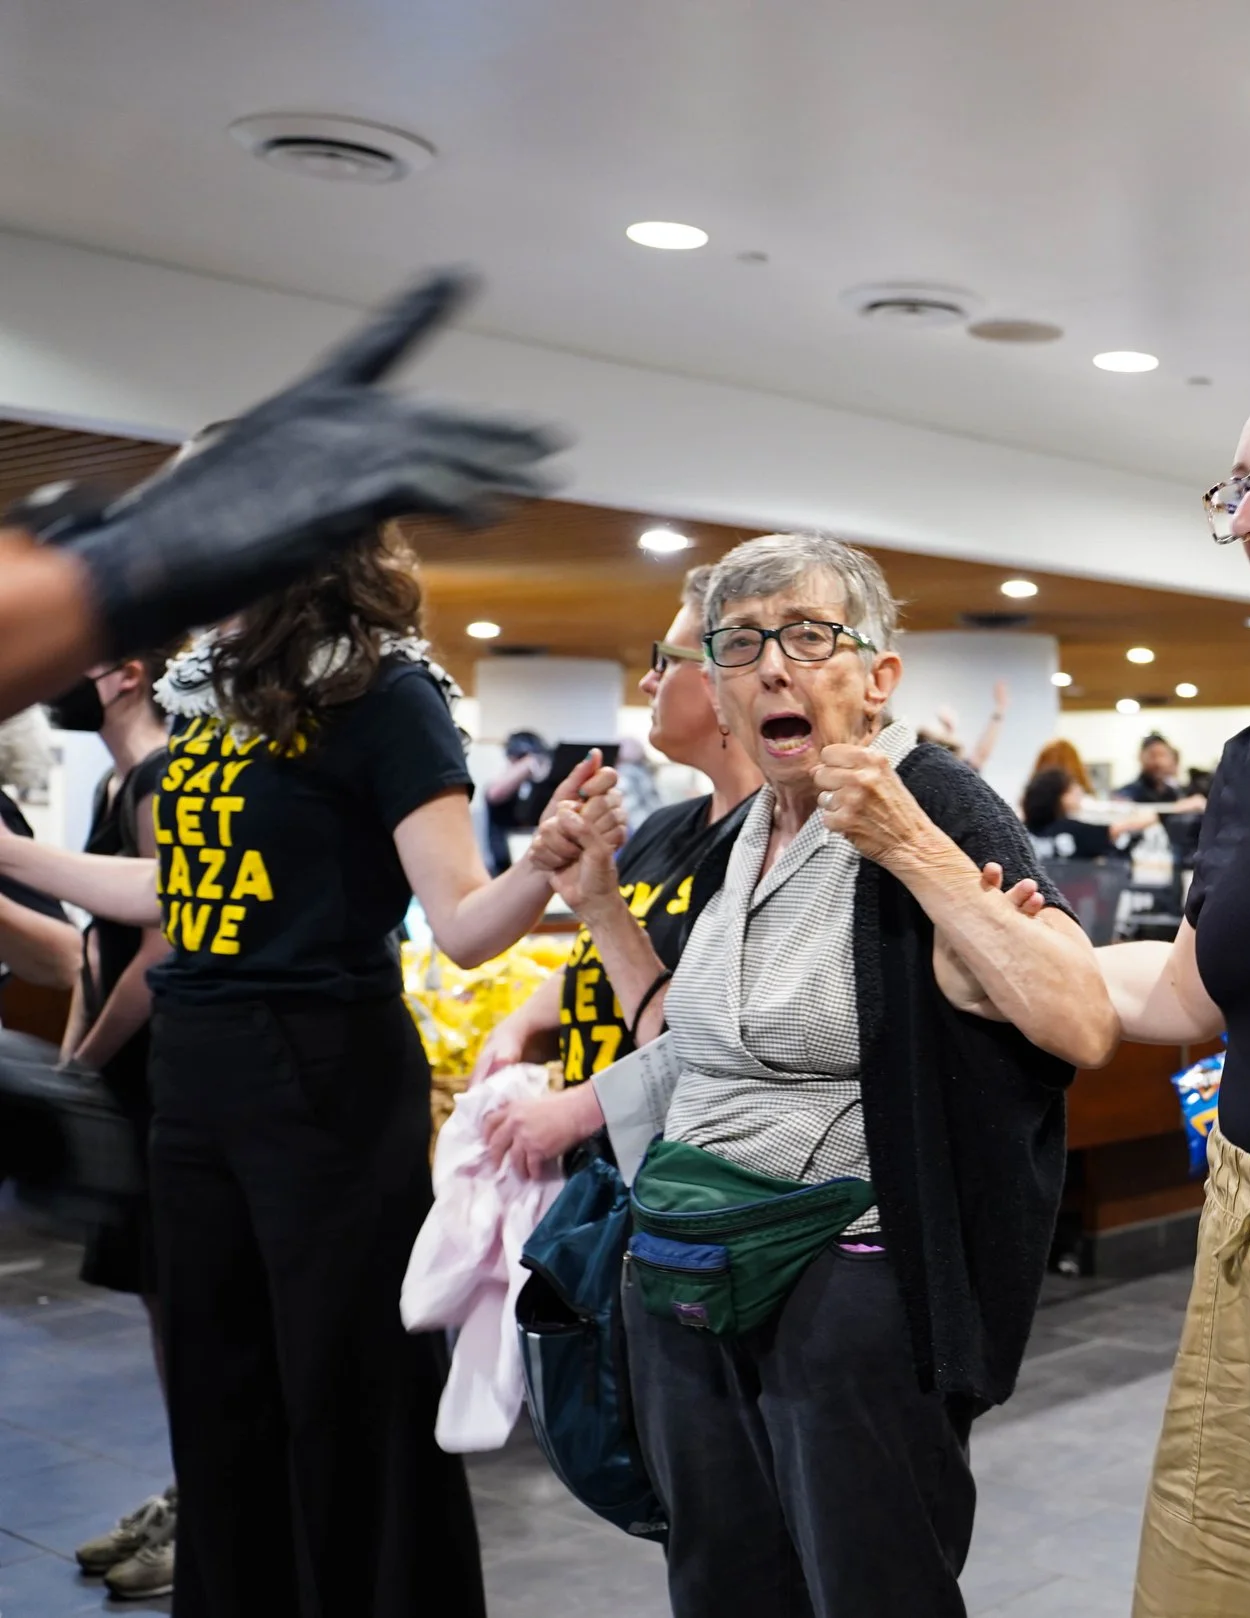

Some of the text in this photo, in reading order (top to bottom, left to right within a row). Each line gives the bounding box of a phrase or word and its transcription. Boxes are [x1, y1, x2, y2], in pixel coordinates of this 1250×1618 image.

[161, 757, 253, 793] SAY
[152, 794, 245, 844] LET
[155, 846, 274, 902] AZA
[156, 898, 247, 955] IVE
[559, 1025, 622, 1082] AZ
